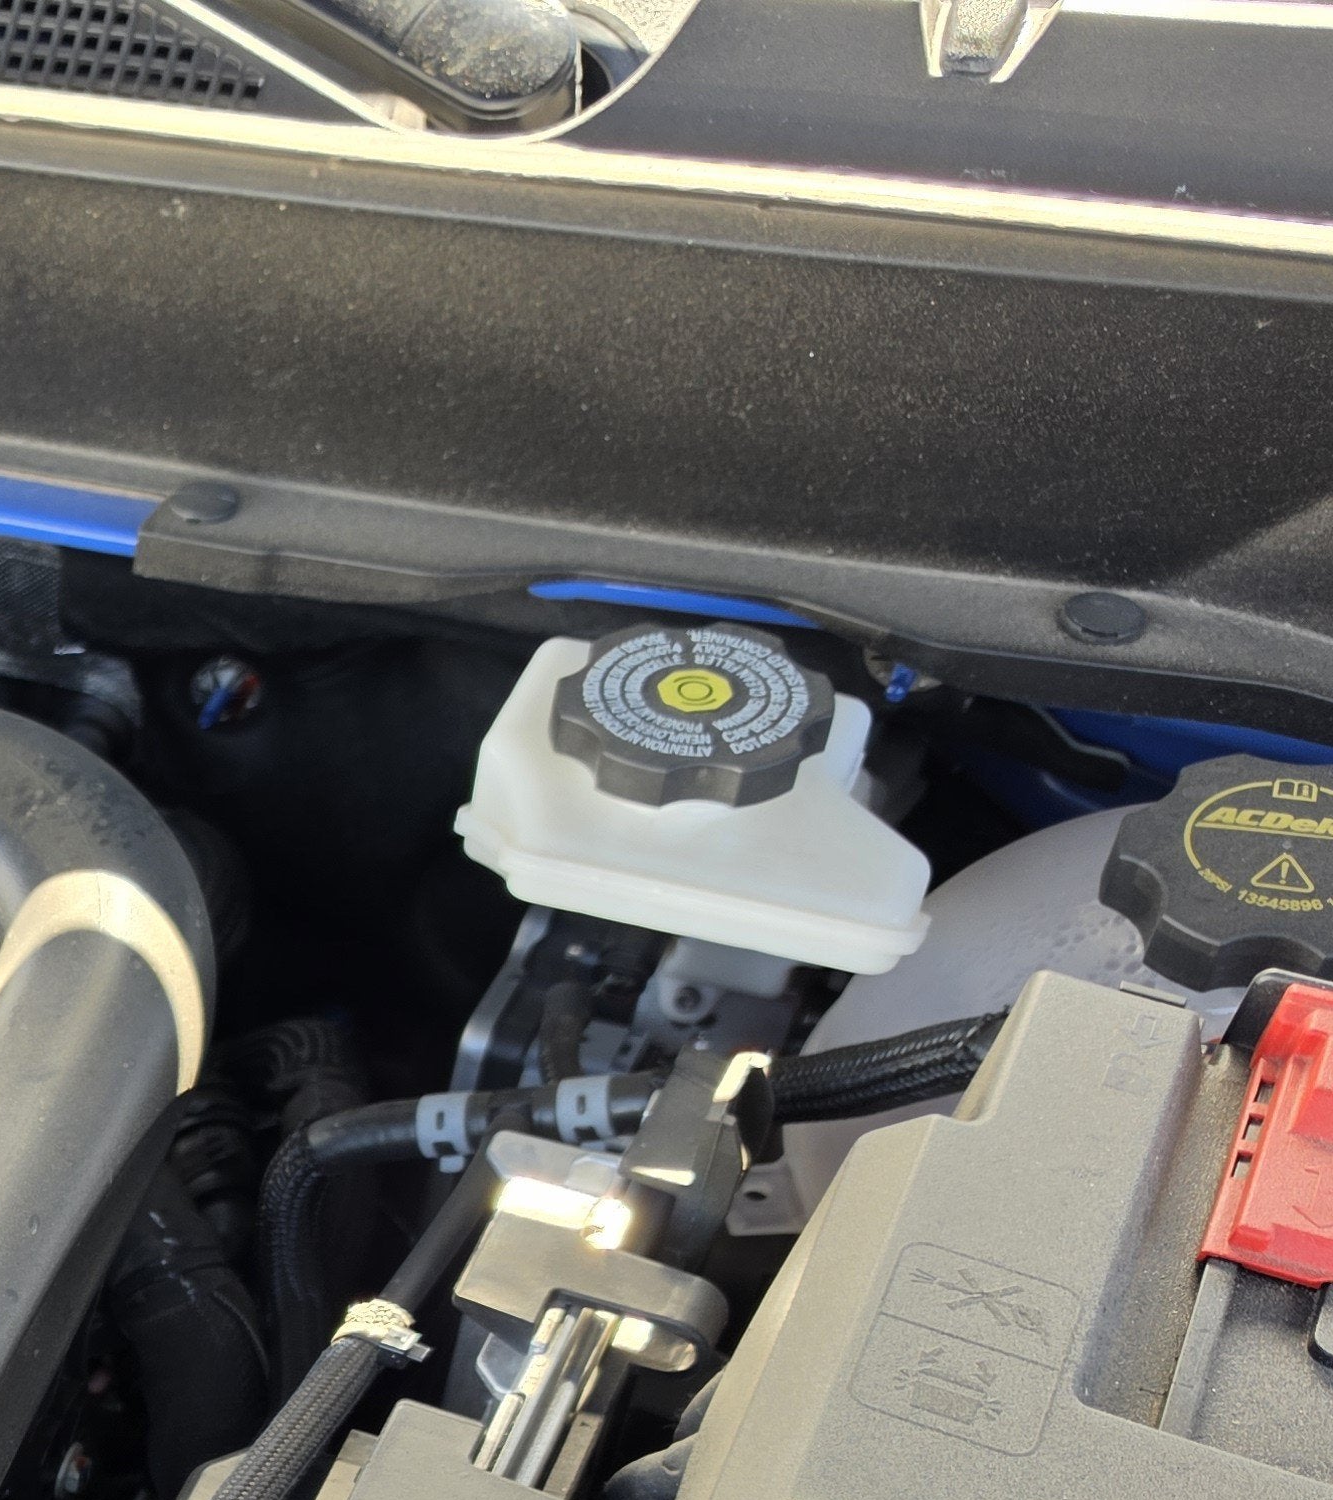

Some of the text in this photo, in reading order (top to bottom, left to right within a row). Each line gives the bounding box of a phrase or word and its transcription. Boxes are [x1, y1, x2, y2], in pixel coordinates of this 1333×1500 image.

[691, 641, 732, 657] ONLY
[693, 653, 742, 674] FILLER
[638, 737, 713, 757] ATTENTION
